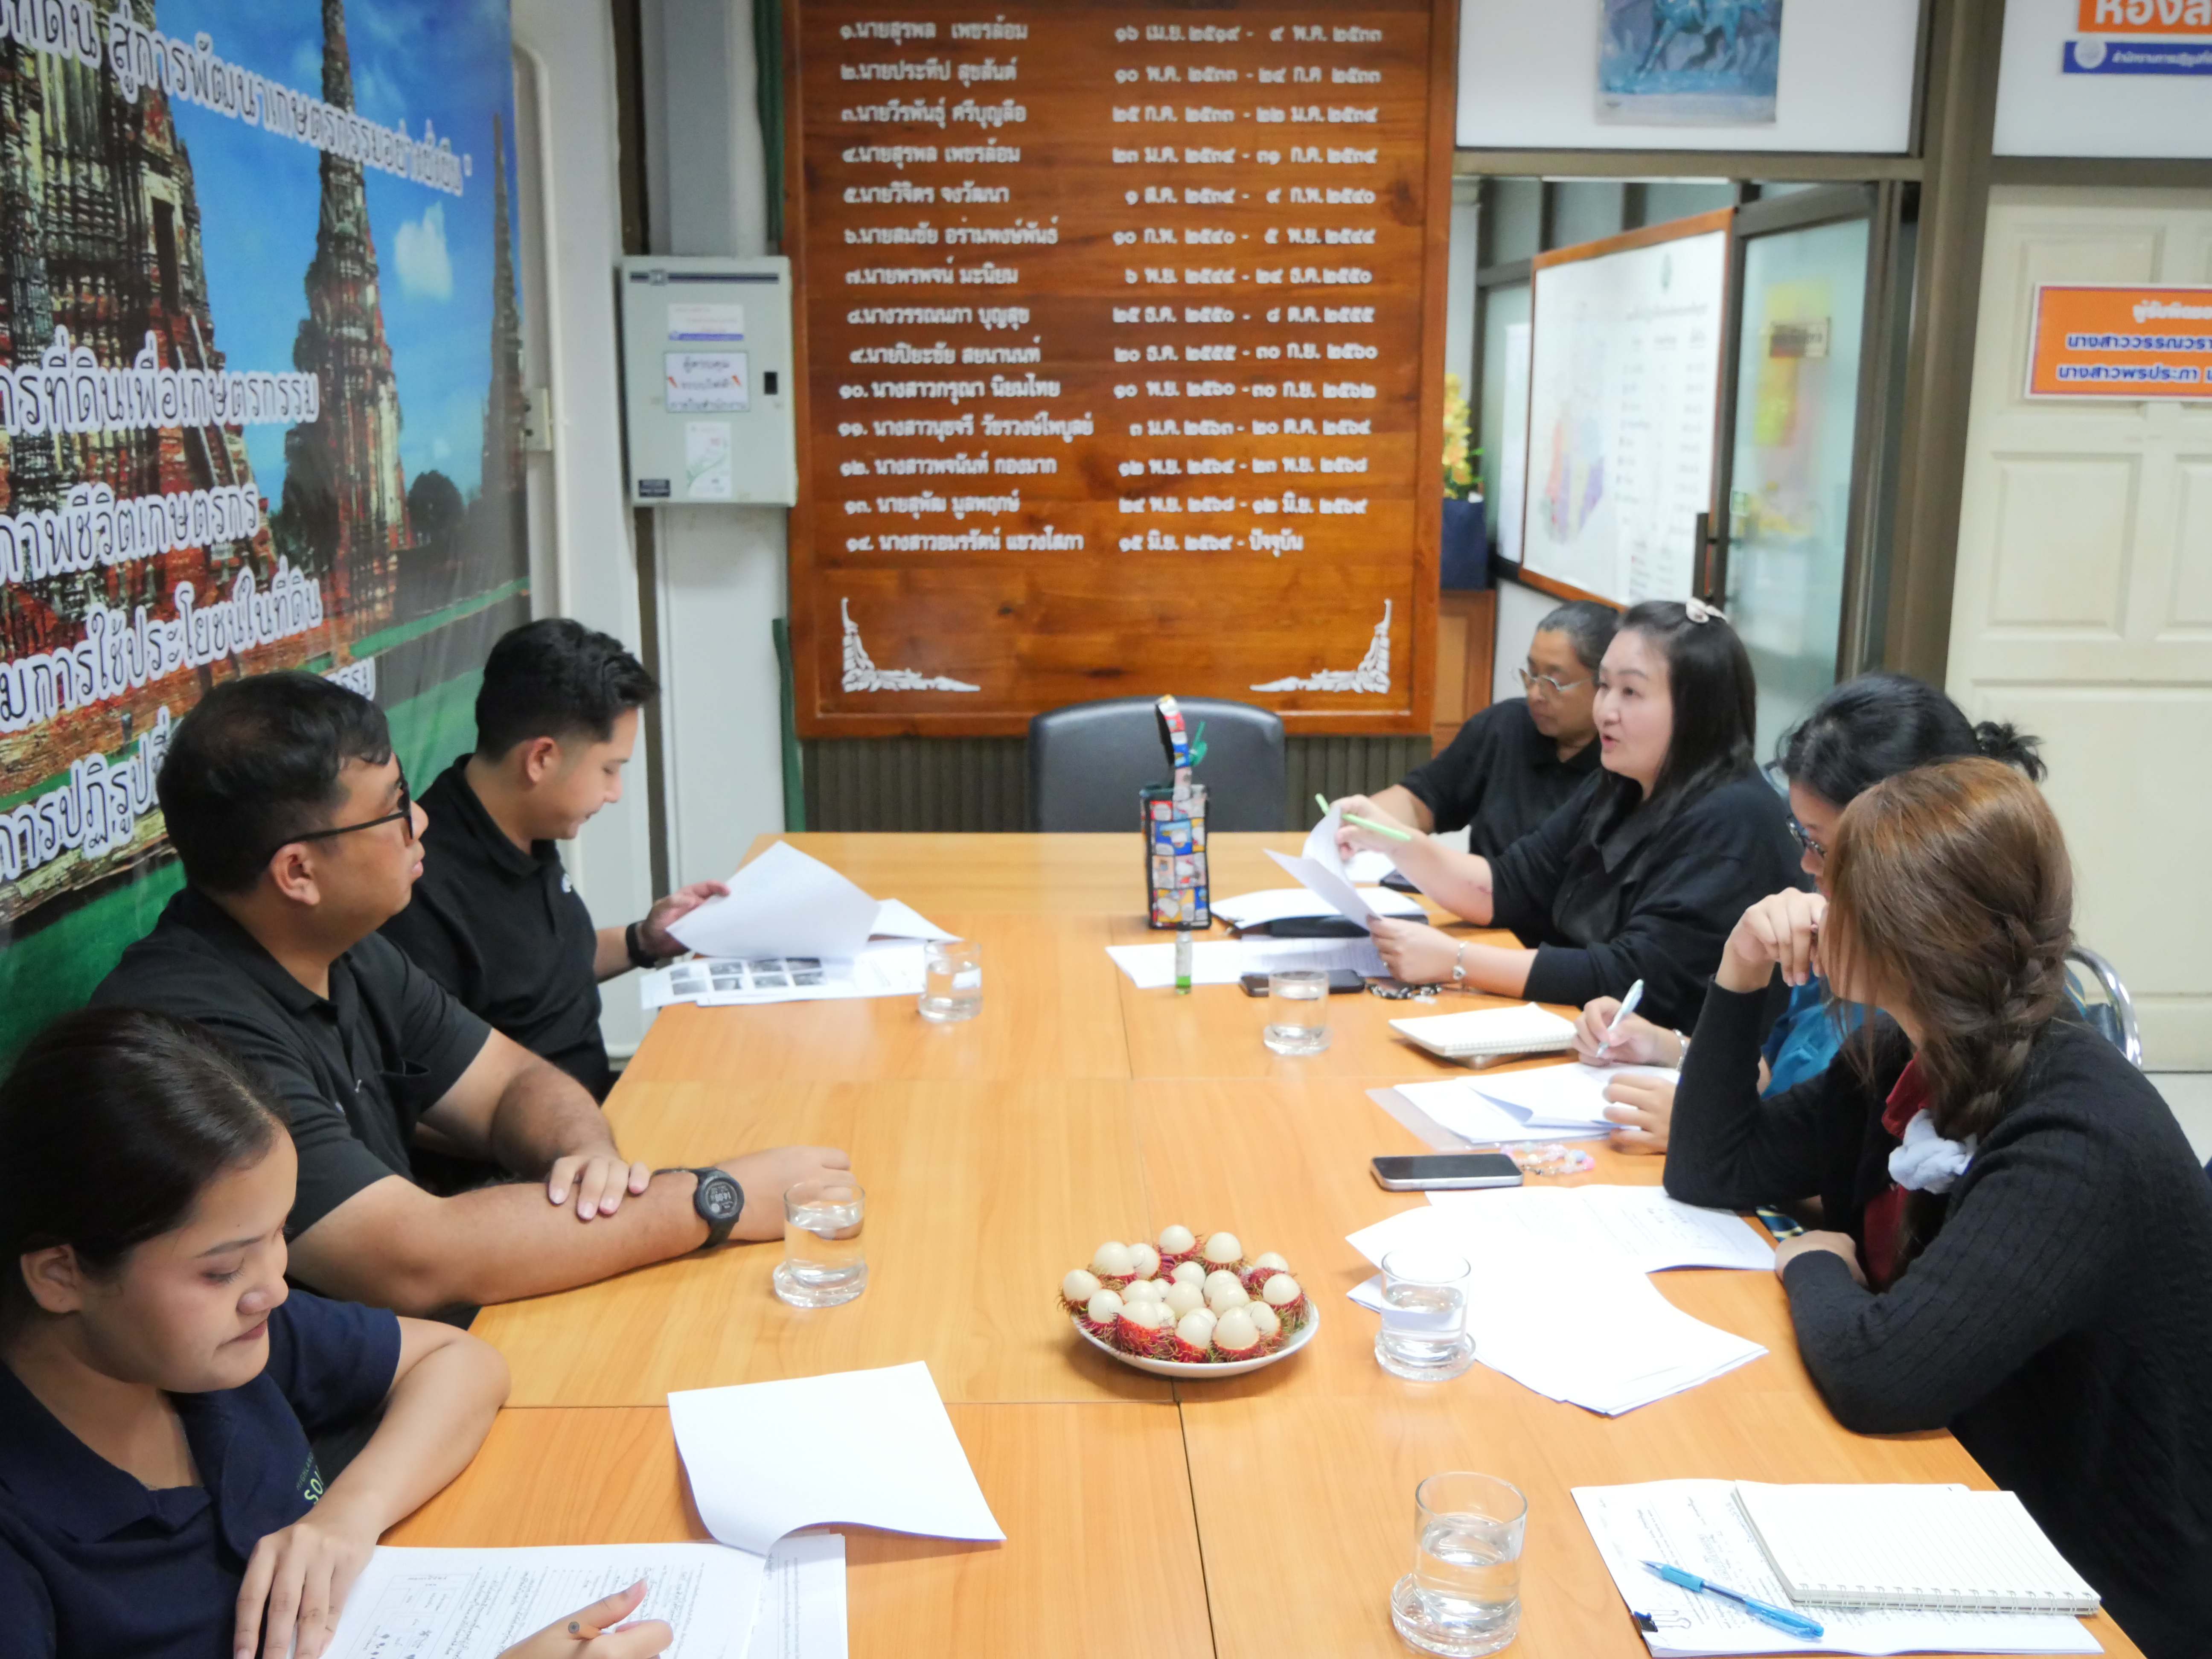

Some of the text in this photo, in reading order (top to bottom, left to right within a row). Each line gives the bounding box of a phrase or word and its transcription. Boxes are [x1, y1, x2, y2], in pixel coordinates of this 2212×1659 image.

[839, 385, 869, 400] ๑๐.
[838, 422, 868, 437] ๑๑.
[840, 460, 870, 477] ๑๒.
[844, 501, 872, 515] ๑๓.
